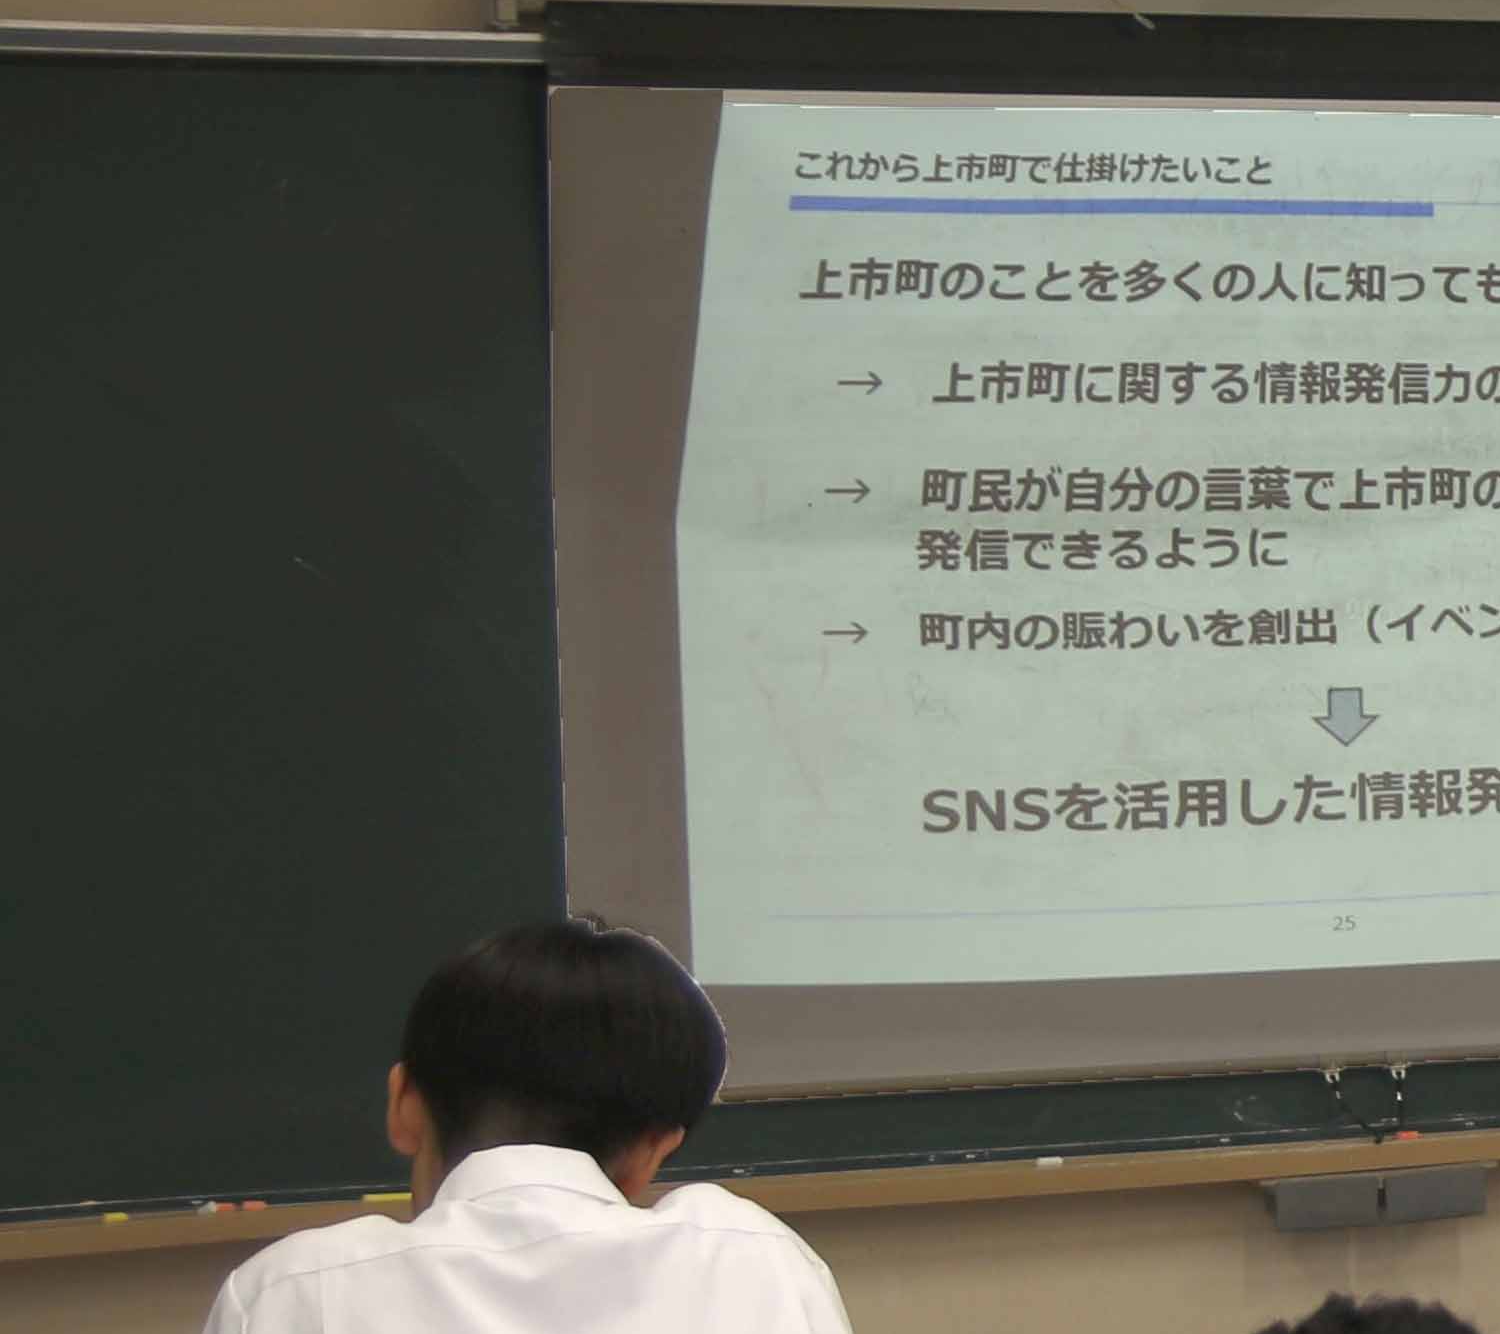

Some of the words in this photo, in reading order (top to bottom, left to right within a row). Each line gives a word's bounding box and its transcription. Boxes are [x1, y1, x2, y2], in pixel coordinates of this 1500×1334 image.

[793, 151, 1274, 186] これから上市町で仕掛けたいこと
[915, 527, 1290, 572] 発信できるように
[1332, 915, 1357, 932] 25
